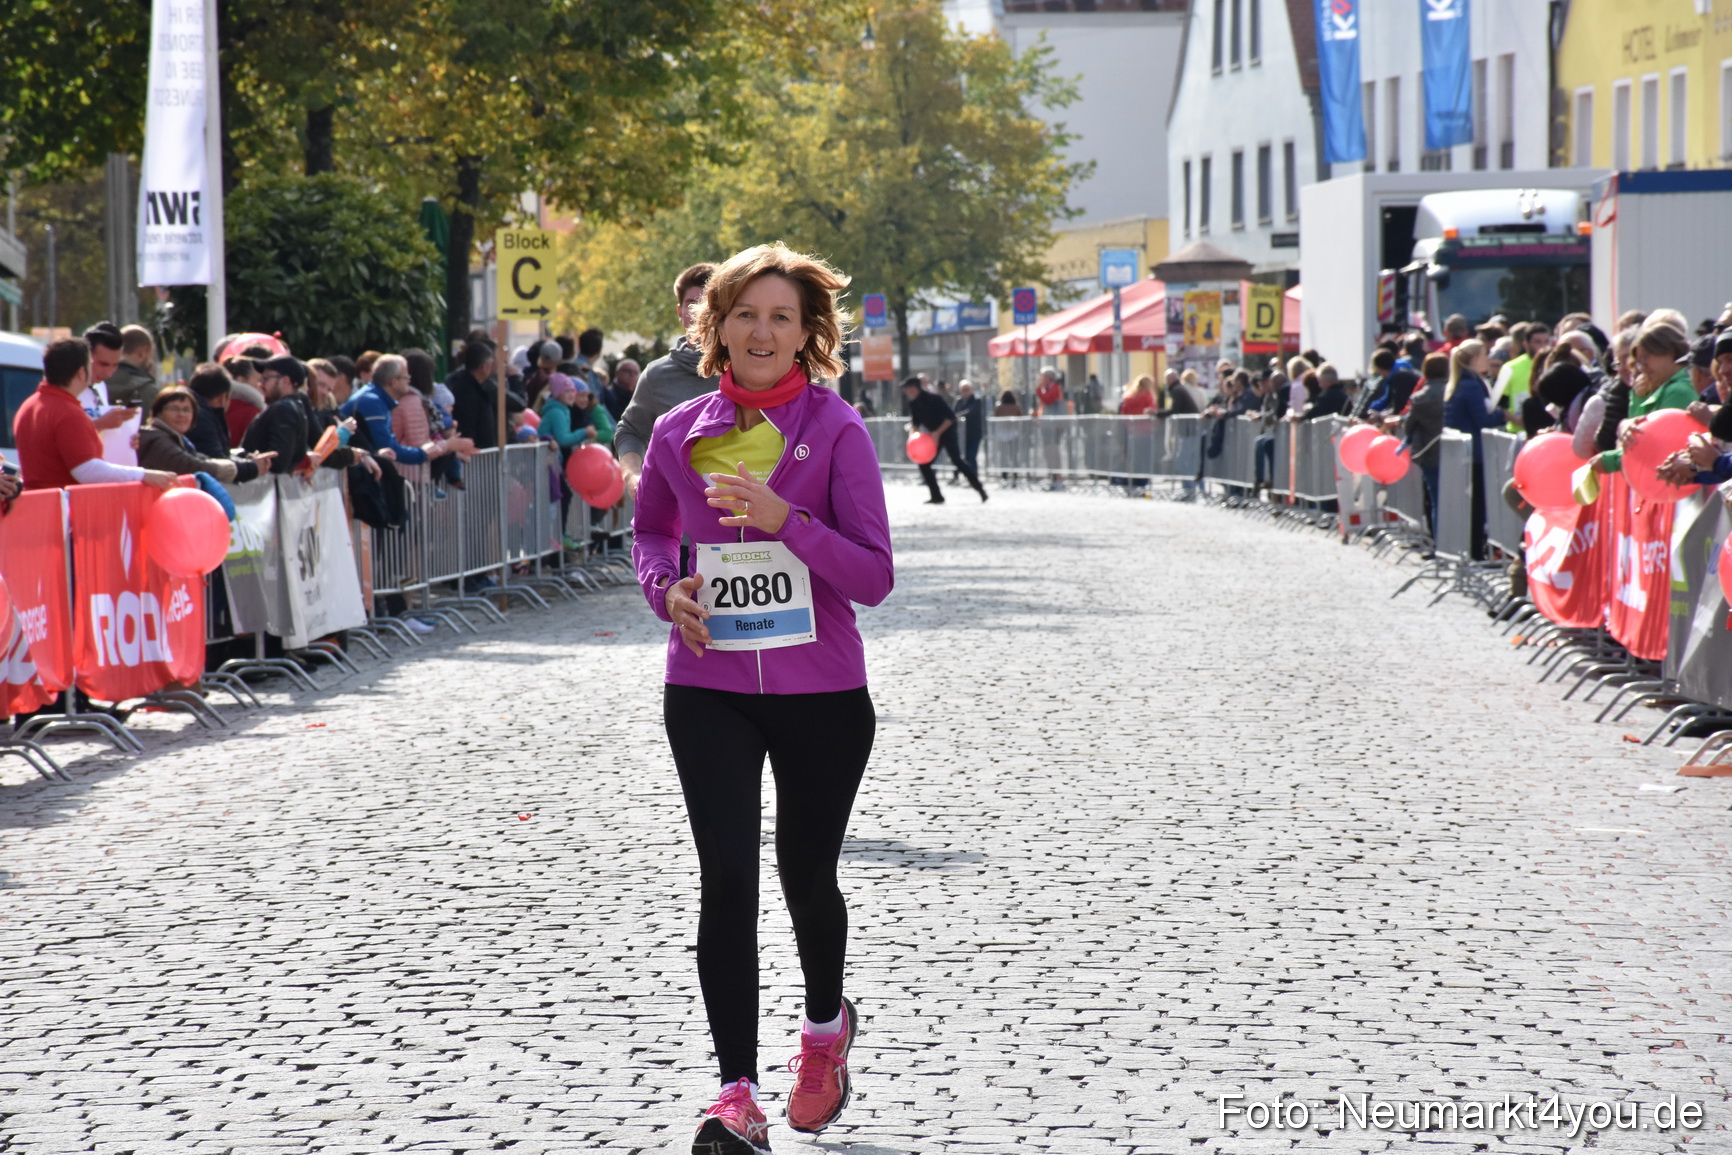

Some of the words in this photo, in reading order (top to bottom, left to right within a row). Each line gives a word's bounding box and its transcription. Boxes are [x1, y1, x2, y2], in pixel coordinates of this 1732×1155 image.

[503, 233, 550, 249] Block
[511, 256, 542, 300] C
[1256, 302, 1275, 329] D
[732, 551, 771, 562] BOCK
[711, 572, 793, 608] 2080
[735, 618, 775, 631] Renate
